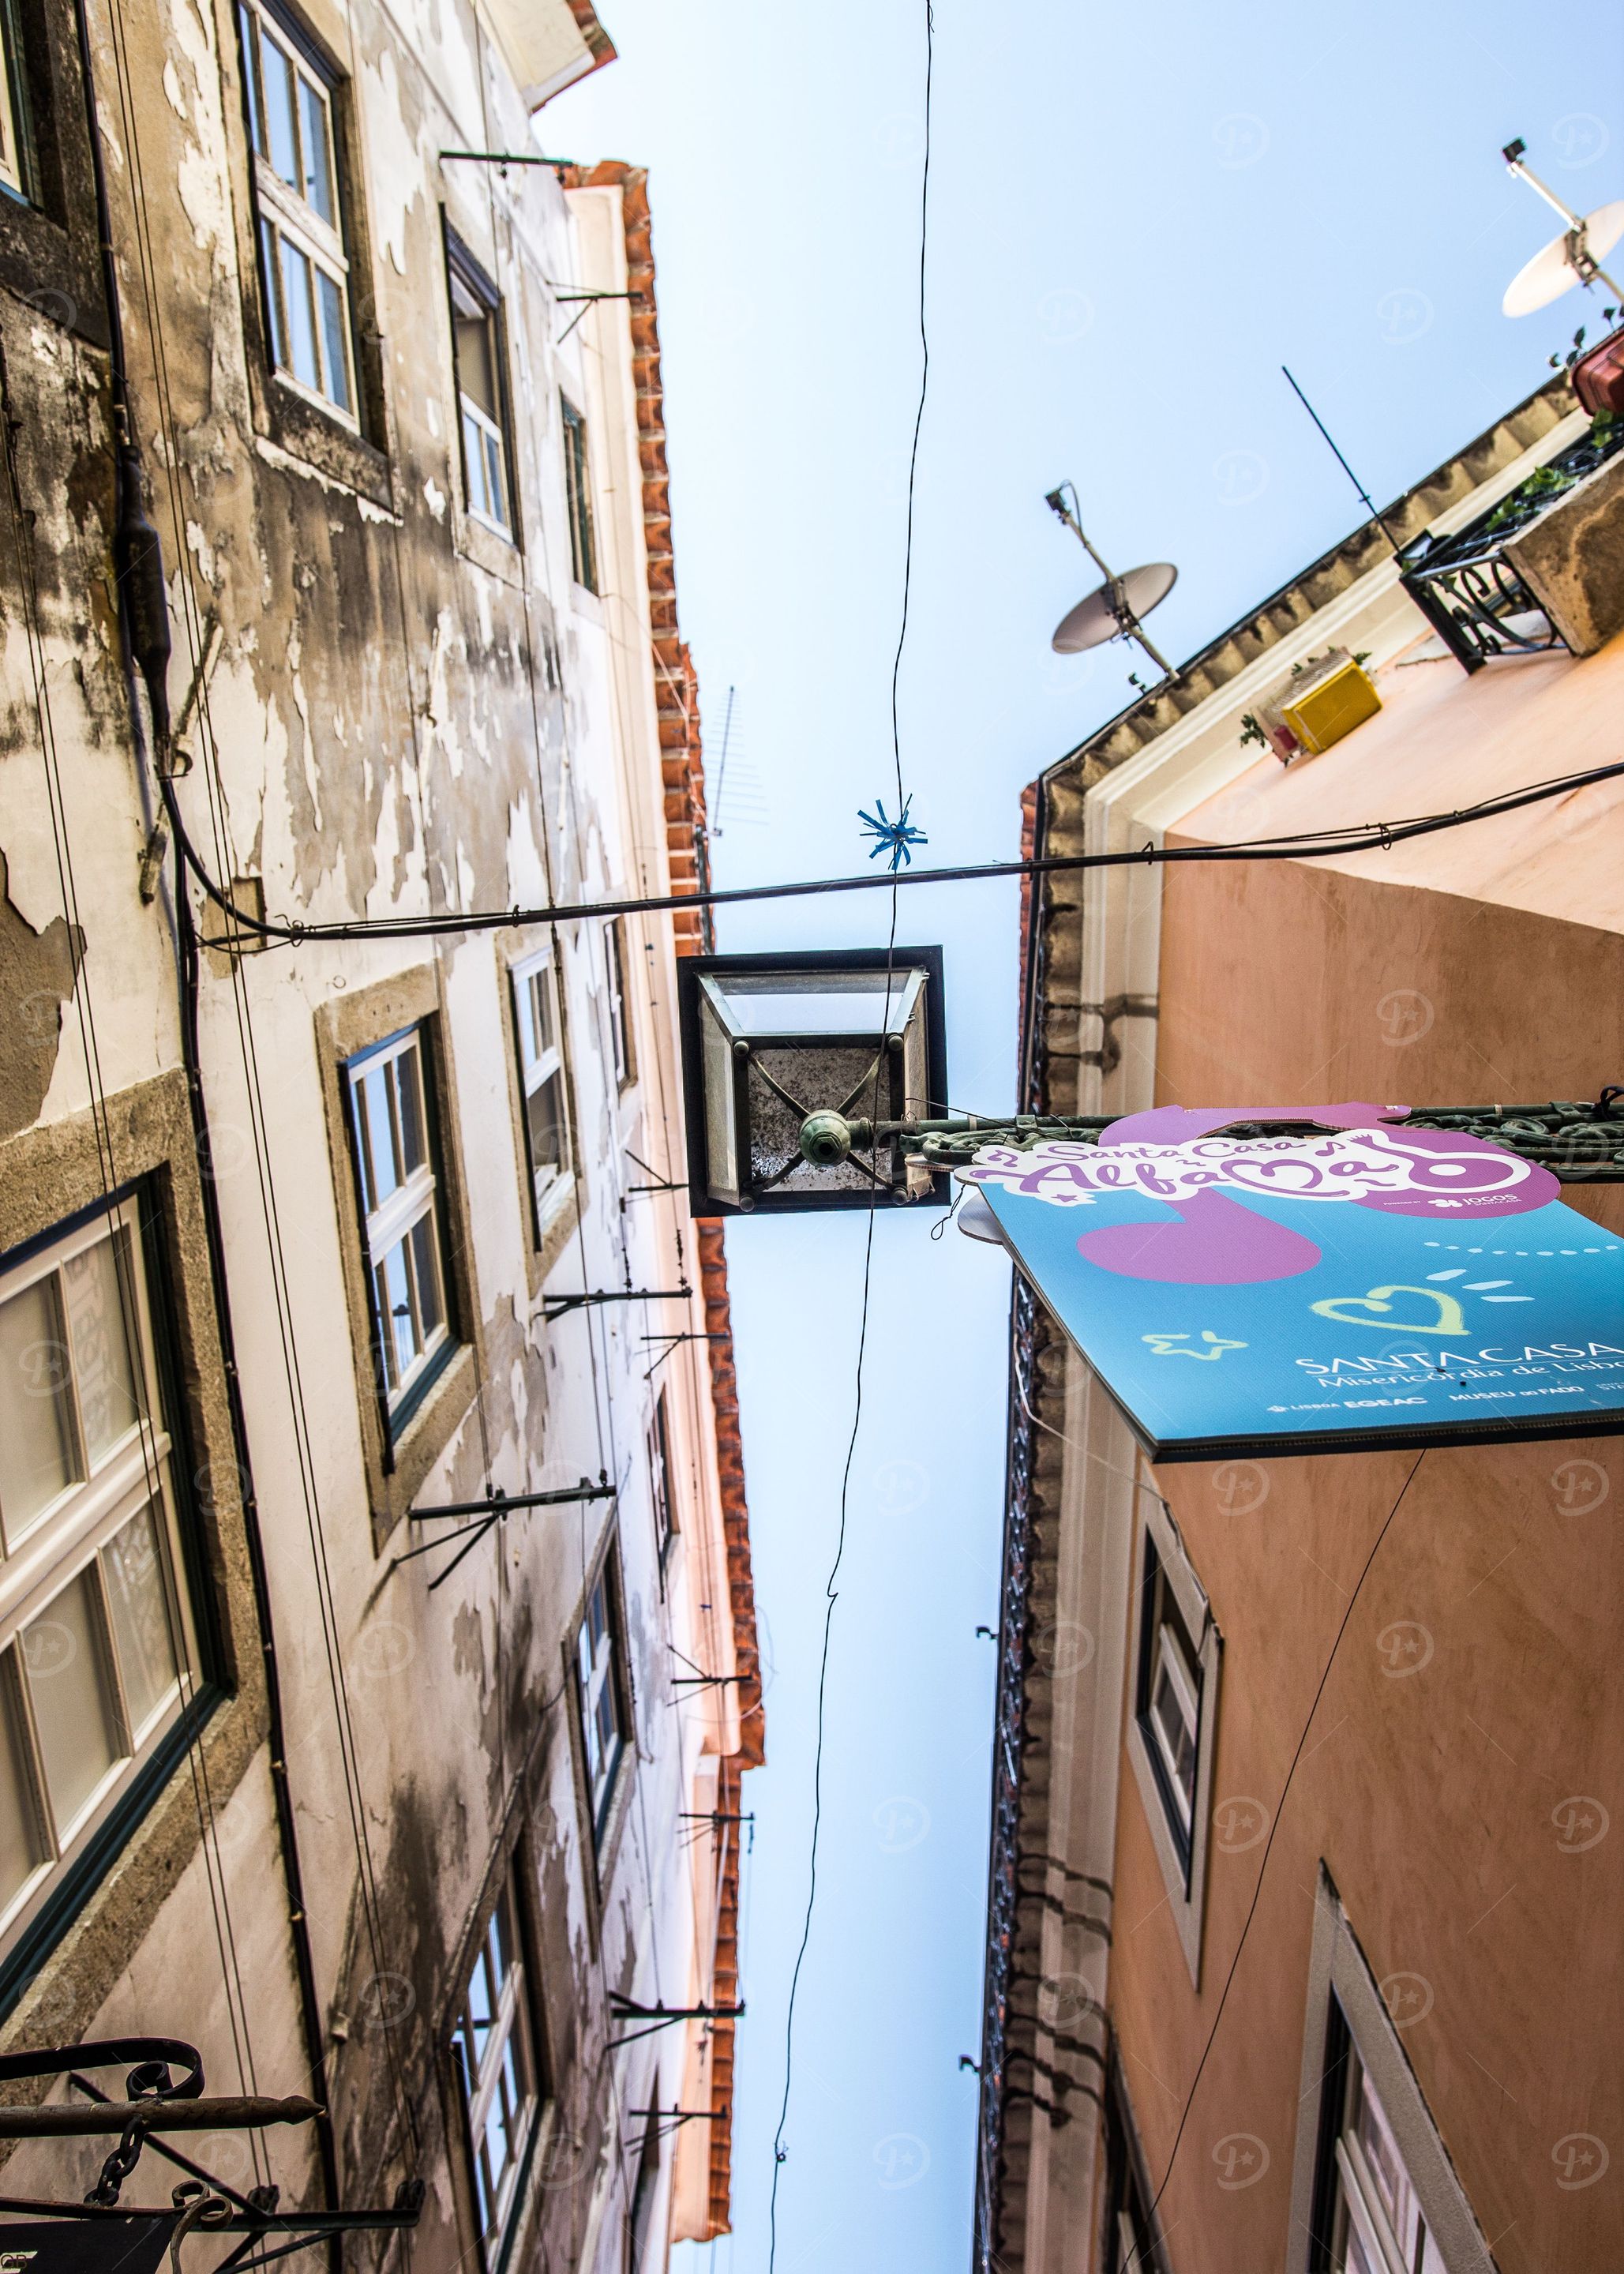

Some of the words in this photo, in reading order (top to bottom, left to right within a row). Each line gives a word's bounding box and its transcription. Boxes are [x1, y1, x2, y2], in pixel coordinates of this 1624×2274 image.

[1037, 1145, 1183, 1161] Santa
[1192, 1142, 1311, 1158] Casa
[1462, 1194, 1517, 1205] JOGOS
[1318, 1368, 1505, 1387] Misericórdia
[1512, 1365, 1551, 1375] de
[1449, 1390, 1516, 1401] MUSEU
[1537, 1386, 1585, 1394] FADO
[1343, 1397, 1428, 1408] EGEAC
